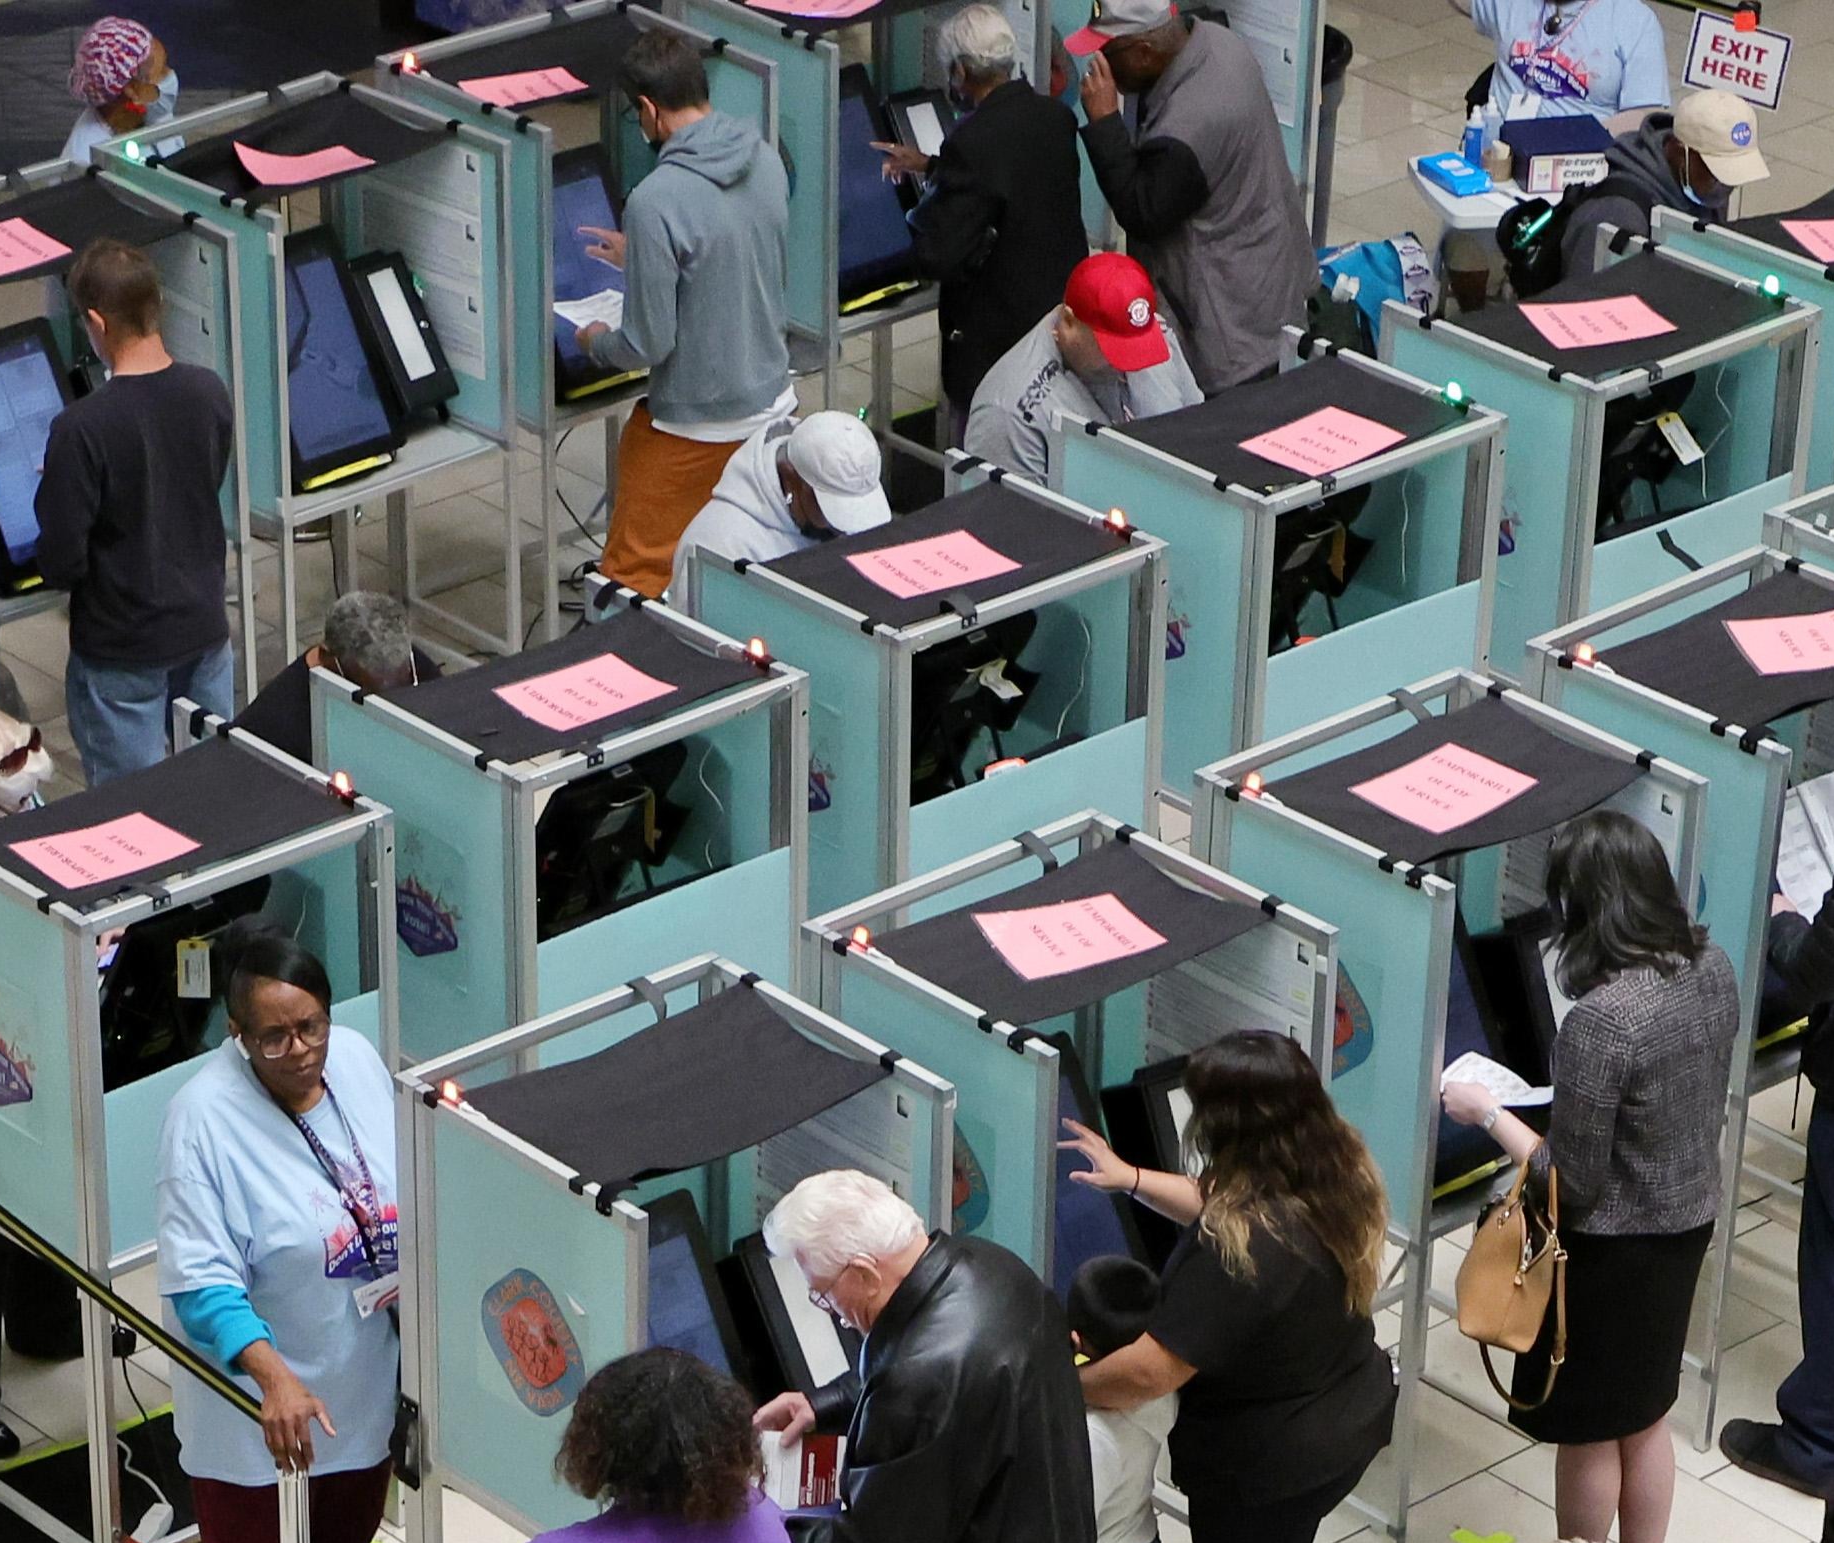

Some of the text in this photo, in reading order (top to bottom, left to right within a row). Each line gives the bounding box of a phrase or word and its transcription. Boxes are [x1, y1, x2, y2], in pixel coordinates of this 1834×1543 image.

[1711, 34, 1768, 65] EXIT
[1701, 56, 1768, 91] HERE
[1427, 775, 1471, 798] OUT OF
[1429, 755, 1513, 795] TEMPORARILY
